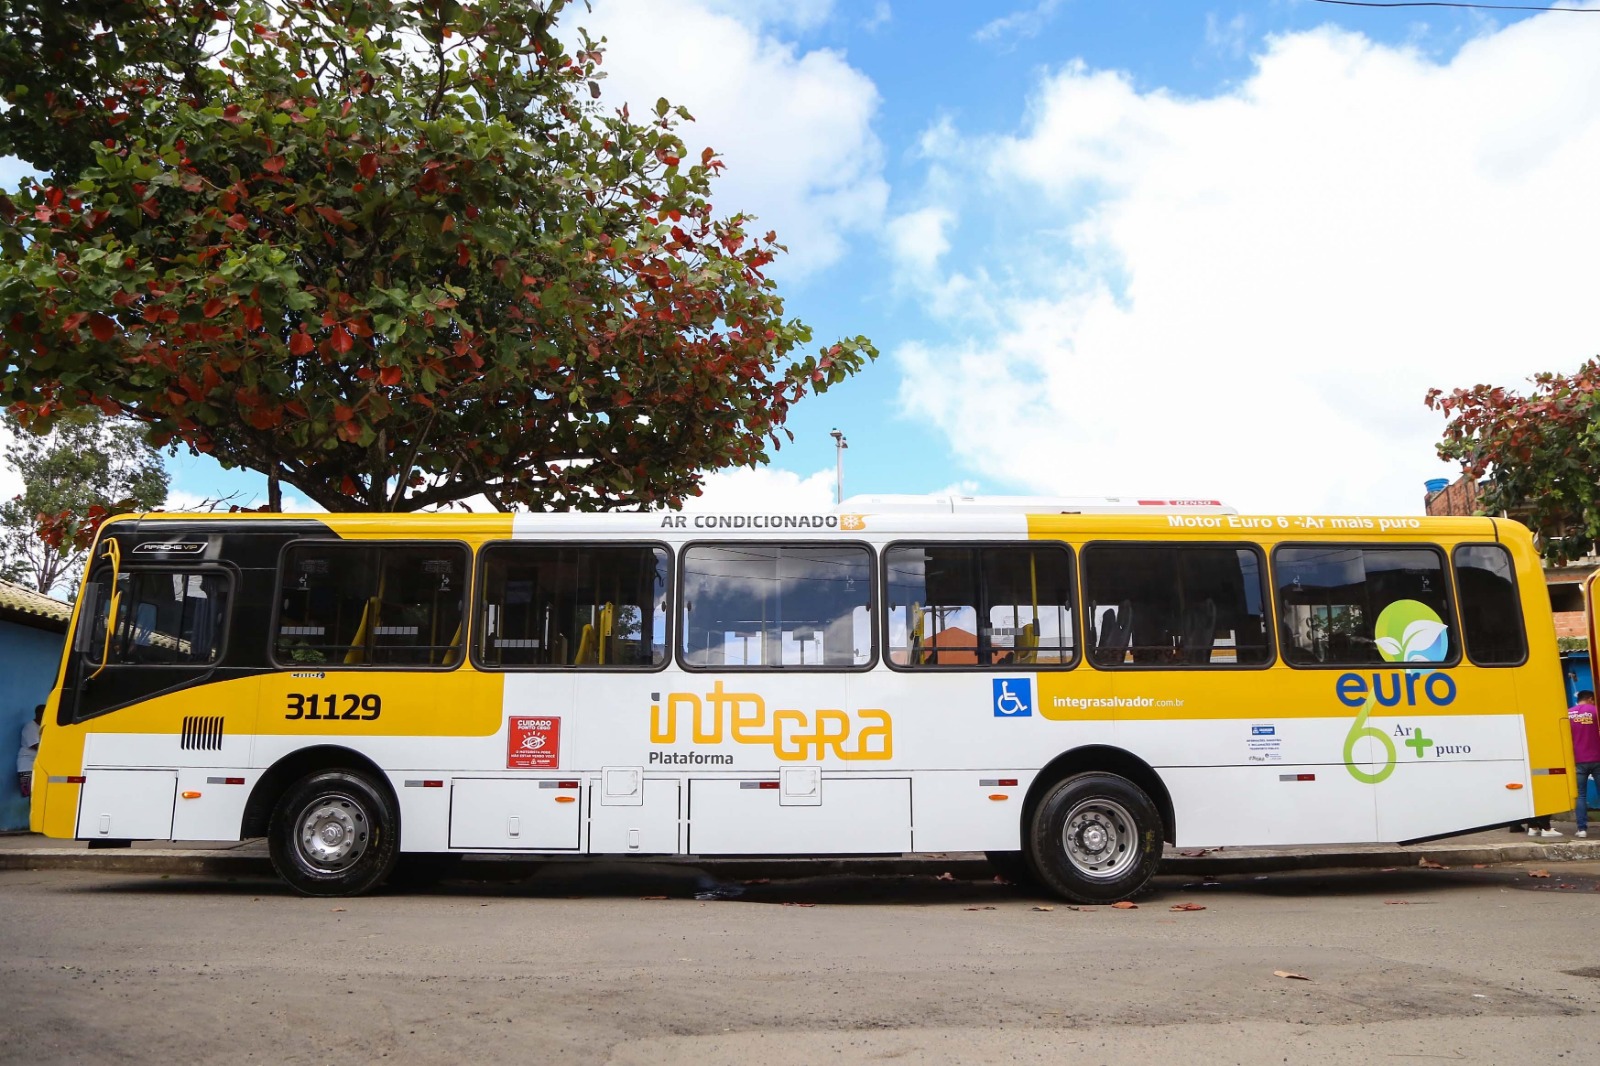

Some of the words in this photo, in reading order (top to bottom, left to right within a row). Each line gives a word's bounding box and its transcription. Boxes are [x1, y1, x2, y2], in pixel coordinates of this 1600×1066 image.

[661, 515, 687, 528] AR
[694, 515, 838, 529] CONDICIONADO
[1167, 515, 1222, 528] Motor
[1228, 516, 1273, 528] Euro
[1277, 516, 1289, 528] 6
[1331, 517, 1374, 528] mais
[1380, 518, 1420, 532] puro
[1335, 672, 1457, 707] euro
[285, 693, 382, 720] 31129
[1053, 696, 1184, 710] integrasalvador.com.br
[1343, 686, 1397, 785] 6
[1394, 724, 1412, 737] Ar
[1436, 745, 1471, 757] puro
[649, 752, 734, 765] Plataforma
